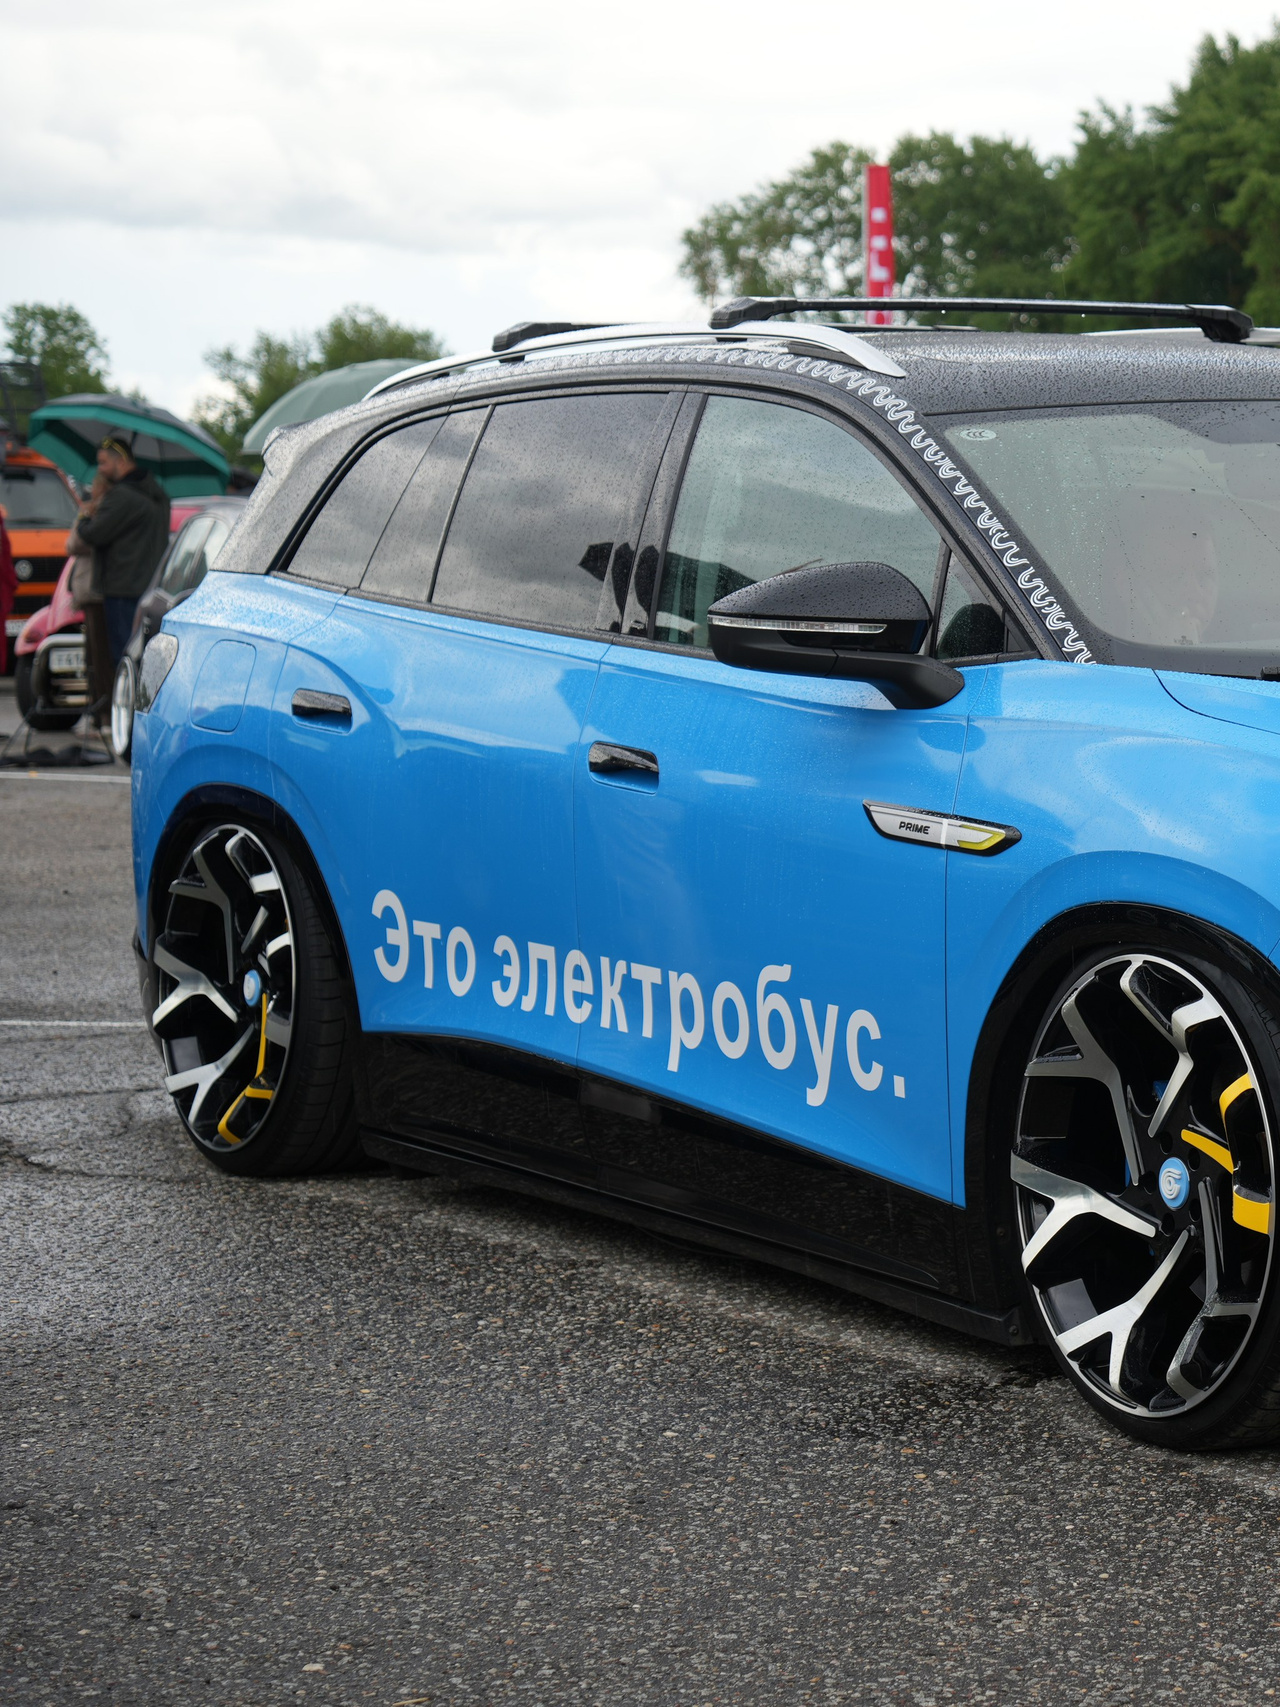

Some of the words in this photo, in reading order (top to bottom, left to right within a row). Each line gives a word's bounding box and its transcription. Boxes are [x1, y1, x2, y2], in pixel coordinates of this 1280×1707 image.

[898, 821, 931, 835] PRIME
[371, 888, 476, 997] Это
[491, 934, 906, 1107] электробус.
